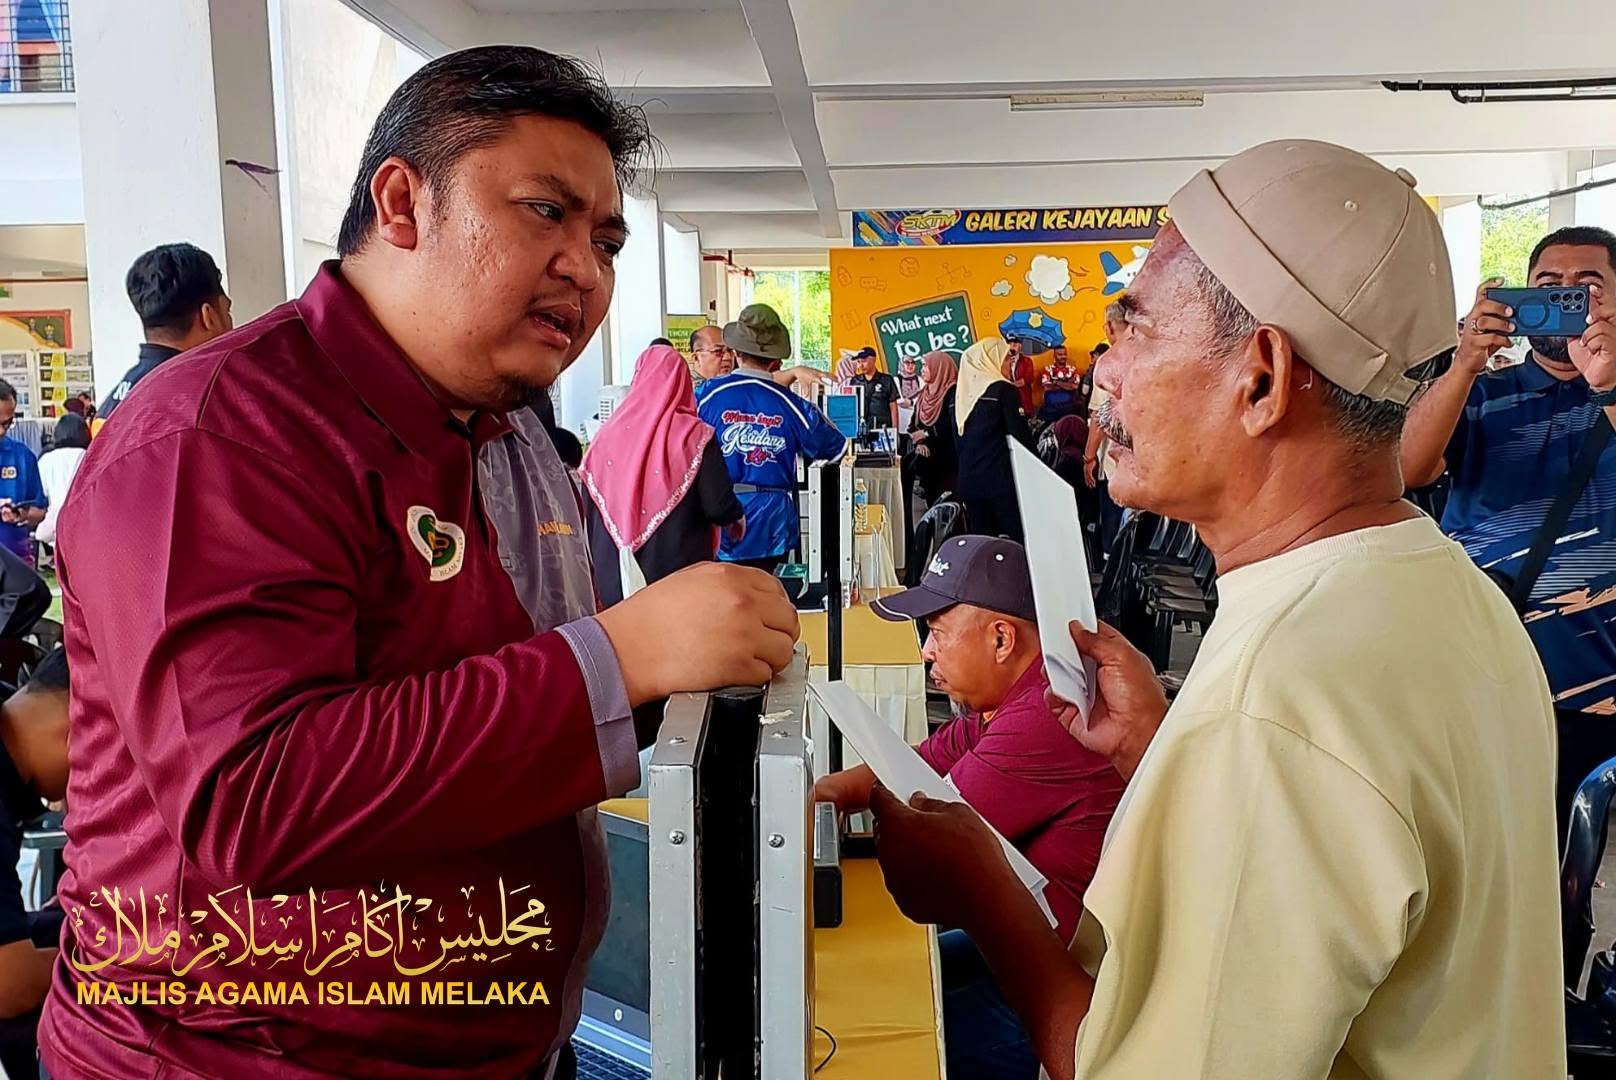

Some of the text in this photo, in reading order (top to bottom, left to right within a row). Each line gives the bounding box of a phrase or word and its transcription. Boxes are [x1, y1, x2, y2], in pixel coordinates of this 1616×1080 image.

[965, 211, 1037, 232] GALERI
[1042, 207, 1152, 230] KEJAYAAN
[881, 305, 953, 335] What next
[894, 340, 920, 361] to
